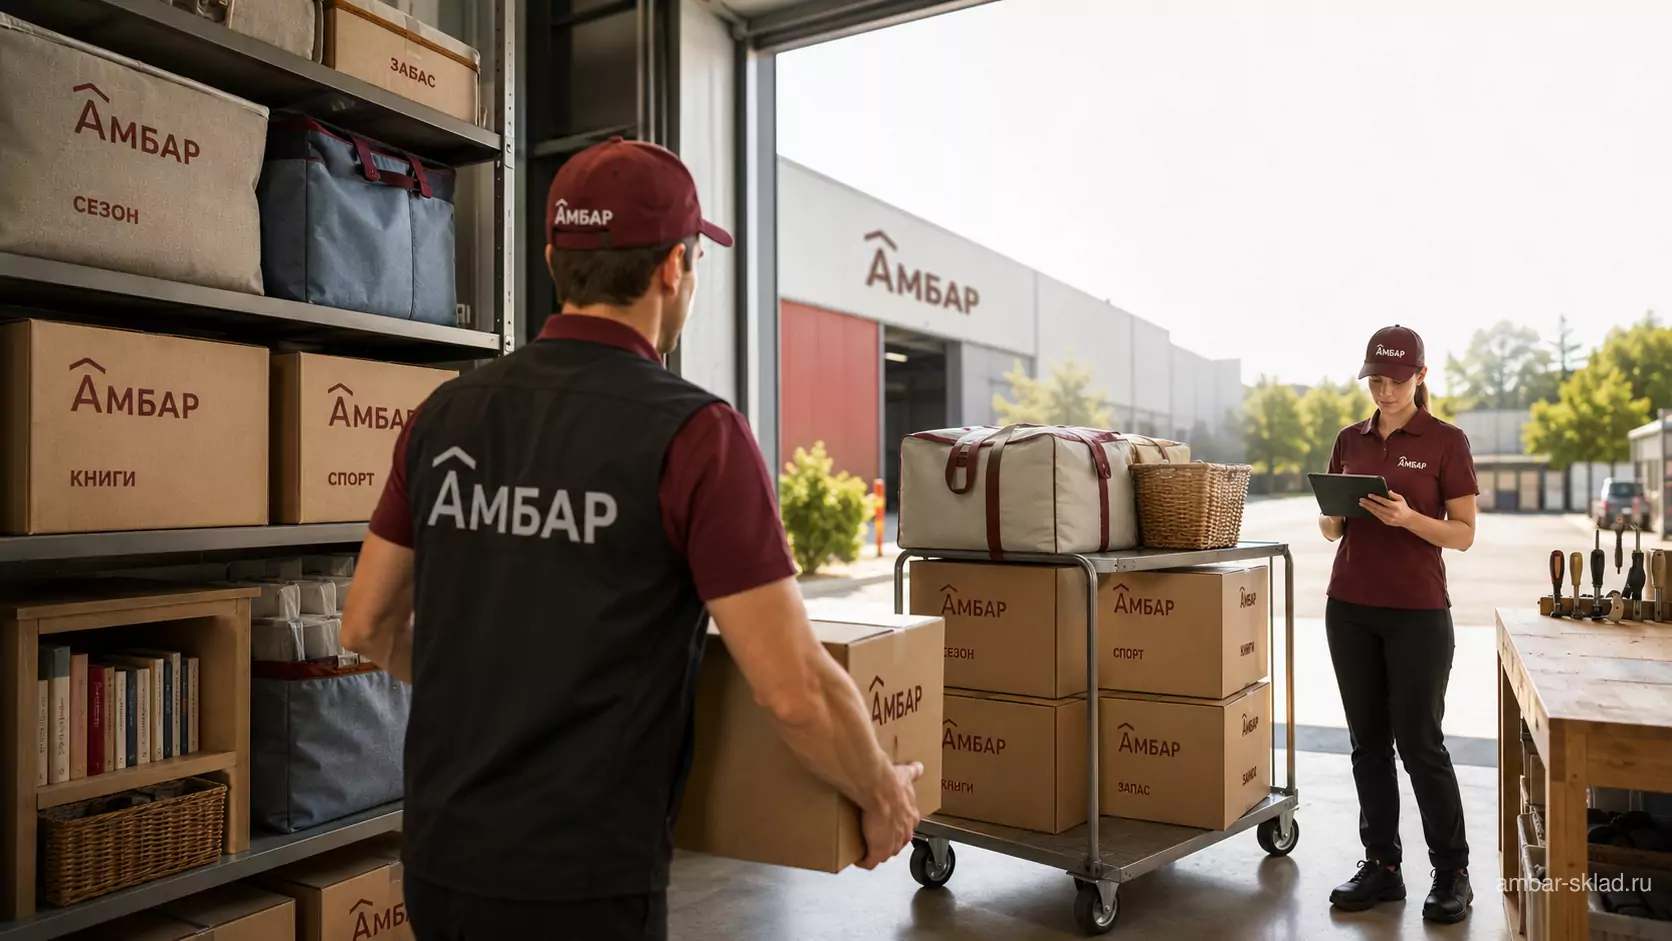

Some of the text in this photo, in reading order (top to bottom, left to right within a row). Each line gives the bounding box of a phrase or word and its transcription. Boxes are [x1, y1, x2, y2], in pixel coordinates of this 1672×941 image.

[390, 57, 436, 88] ЗАБАС
[73, 98, 201, 165] АМБАР
[73, 195, 139, 225] СЕЗОН
[554, 205, 614, 226] АМБАР
[864, 246, 980, 316] АМБАР
[70, 374, 200, 419] АМБАР
[70, 469, 136, 487] КНИГИ
[328, 472, 375, 486] СПОРТ
[427, 470, 618, 544] АМБАР
[941, 593, 1008, 618] АМБАР
[1113, 592, 1175, 616] АМБАР
[1113, 647, 1144, 660] СПОРТ
[871, 685, 922, 726] АМБАР
[941, 727, 1006, 755] АМБАР
[1118, 731, 1181, 757] АМБАР
[1118, 782, 1150, 795] ЗАПАС
[352, 902, 409, 941] АМБ
